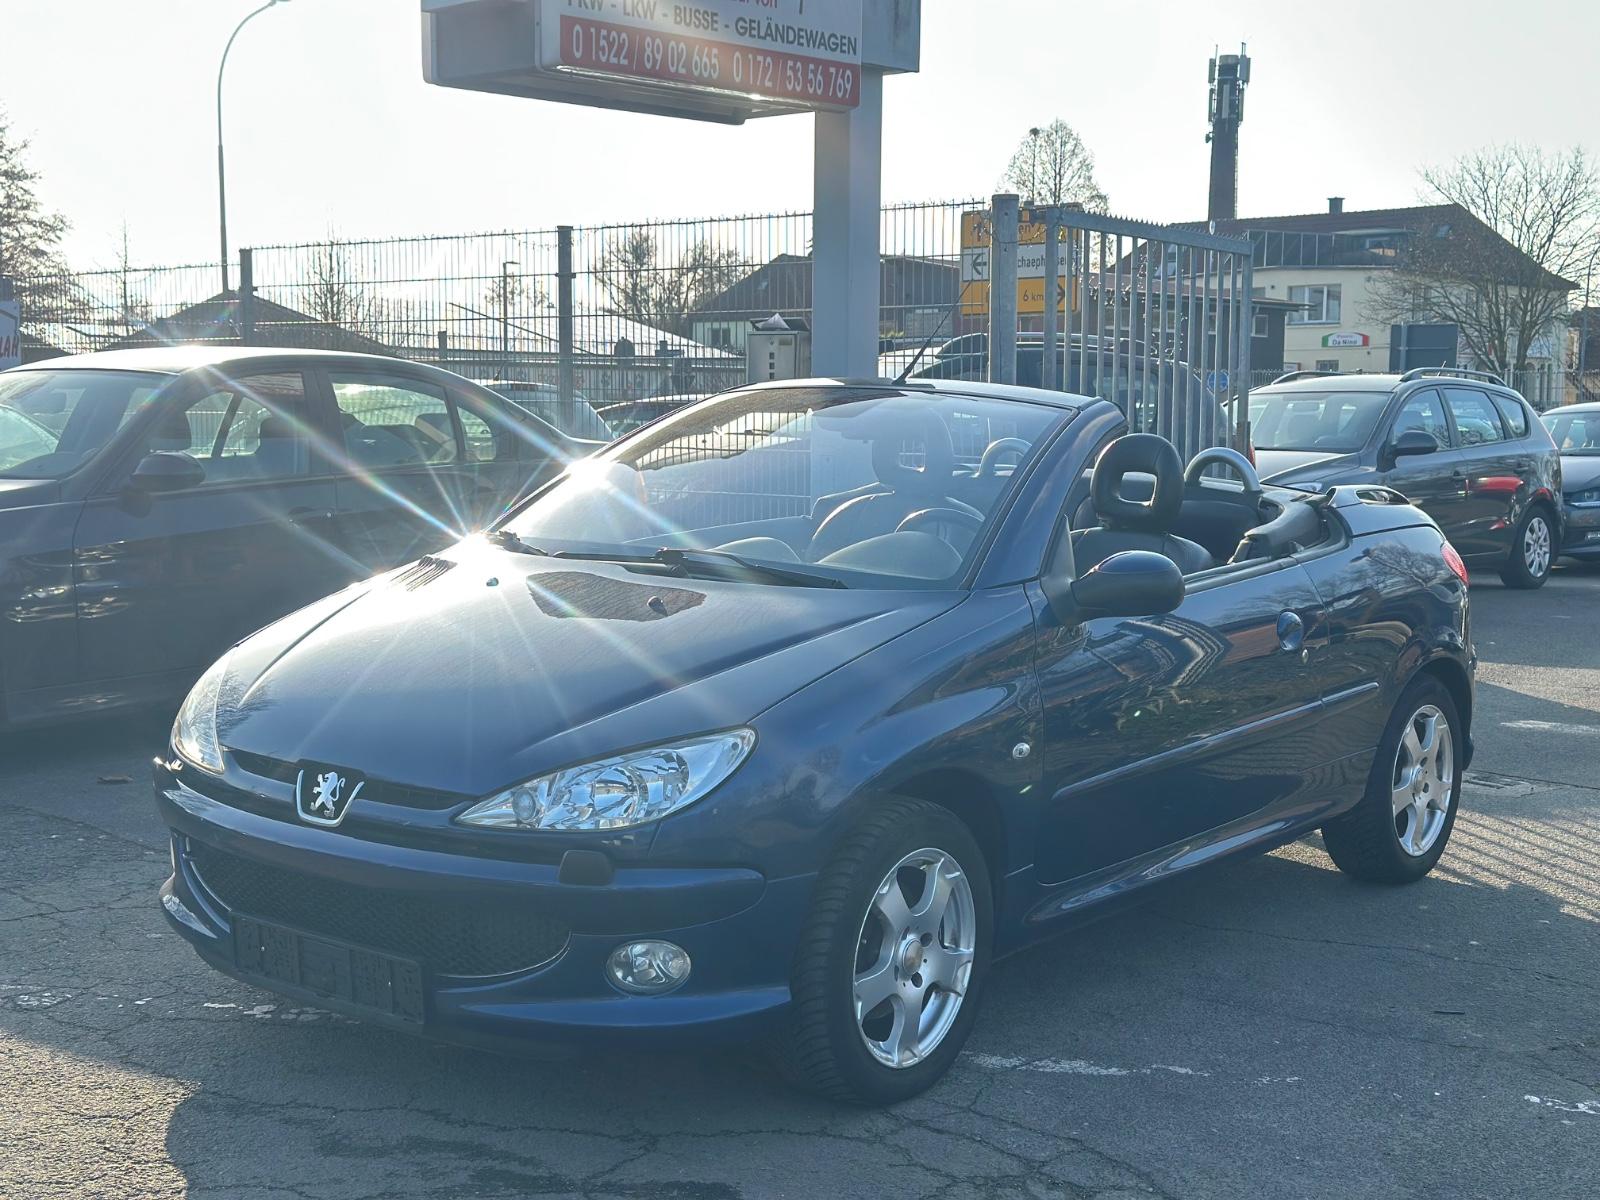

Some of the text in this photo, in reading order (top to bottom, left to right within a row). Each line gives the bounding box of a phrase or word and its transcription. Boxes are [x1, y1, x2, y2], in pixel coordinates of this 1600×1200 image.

[623, 0, 657, 20] LKW
[674, 5, 719, 32] BUSSE
[734, 15, 857, 56] GELÄNDEWAGEN
[572, 23, 583, 59] 0
[590, 27, 629, 65] 1522
[644, 36, 663, 70] 89
[667, 40, 687, 74] 02
[691, 44, 720, 79] 665
[733, 50, 743, 84] 0
[747, 52, 773, 88] 172
[785, 59, 803, 92] 53
[806, 63, 824, 96] 56
[828, 66, 853, 99] 769
[1023, 289, 1029, 302] 6
